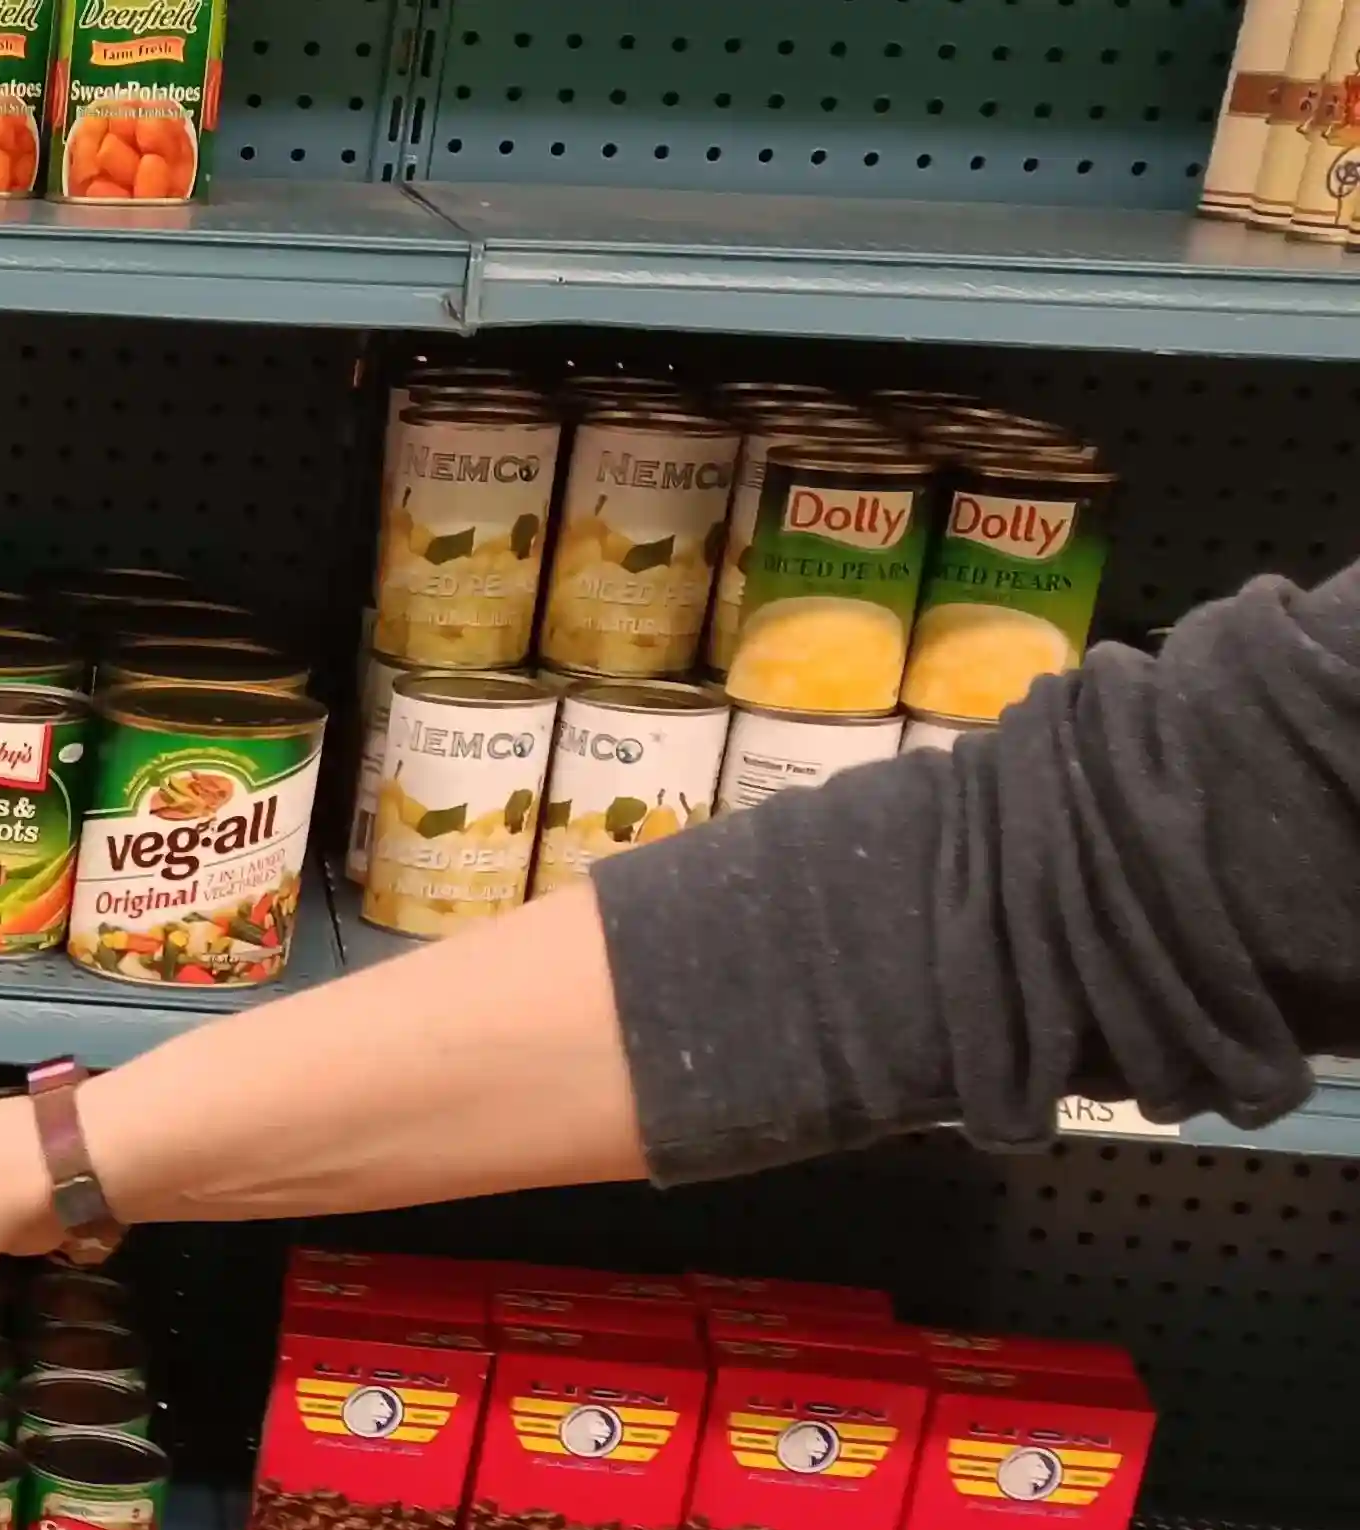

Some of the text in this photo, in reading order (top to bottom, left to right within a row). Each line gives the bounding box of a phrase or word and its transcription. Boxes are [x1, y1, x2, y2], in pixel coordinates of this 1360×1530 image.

[79, 0, 204, 34] Deerfield
[137, 42, 173, 57] Fresh
[404, 441, 542, 484] NEMCO
[789, 490, 906, 546] Dolly
[951, 496, 1067, 557] Dolly
[993, 571, 1073, 593] PEARS
[396, 715, 536, 759] NEMCO
[555, 719, 645, 764] EMCO
[12, 796, 36, 819] &
[95, 878, 199, 919] Original
[1056, 1100, 1115, 1123] ARS
[745, 1394, 891, 1422] LION
